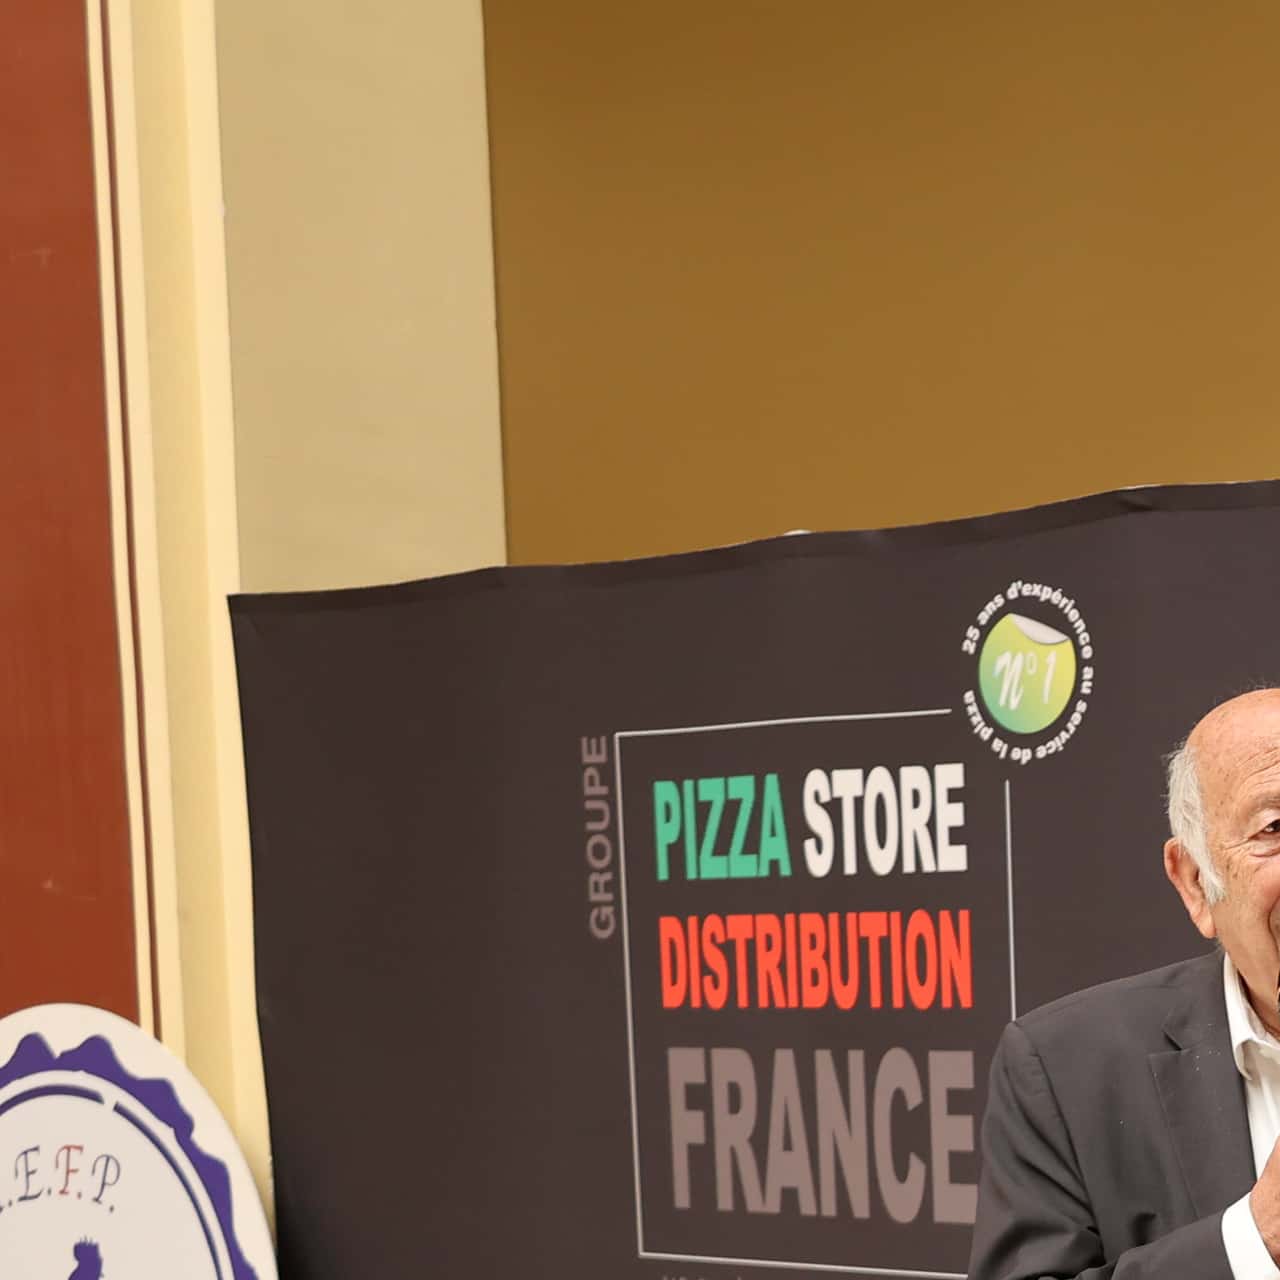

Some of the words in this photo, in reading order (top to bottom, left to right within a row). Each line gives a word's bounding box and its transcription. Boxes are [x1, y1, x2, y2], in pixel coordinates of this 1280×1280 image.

[977, 593, 1006, 626] ans
[1006, 580, 1093, 660] d'expérience
[961, 625, 981, 655] 25
[1080, 666, 1094, 695] au
[963, 689, 995, 741] pizza
[1035, 699, 1088, 760] service
[991, 737, 1008, 759] la
[1010, 746, 1032, 766] de
[581, 734, 617, 939] GROUPE
[653, 773, 793, 882] PIZZA
[803, 762, 968, 879] STORE
[658, 909, 974, 1011] DISTRIBUTION
[667, 1045, 979, 1226] FRANCE
